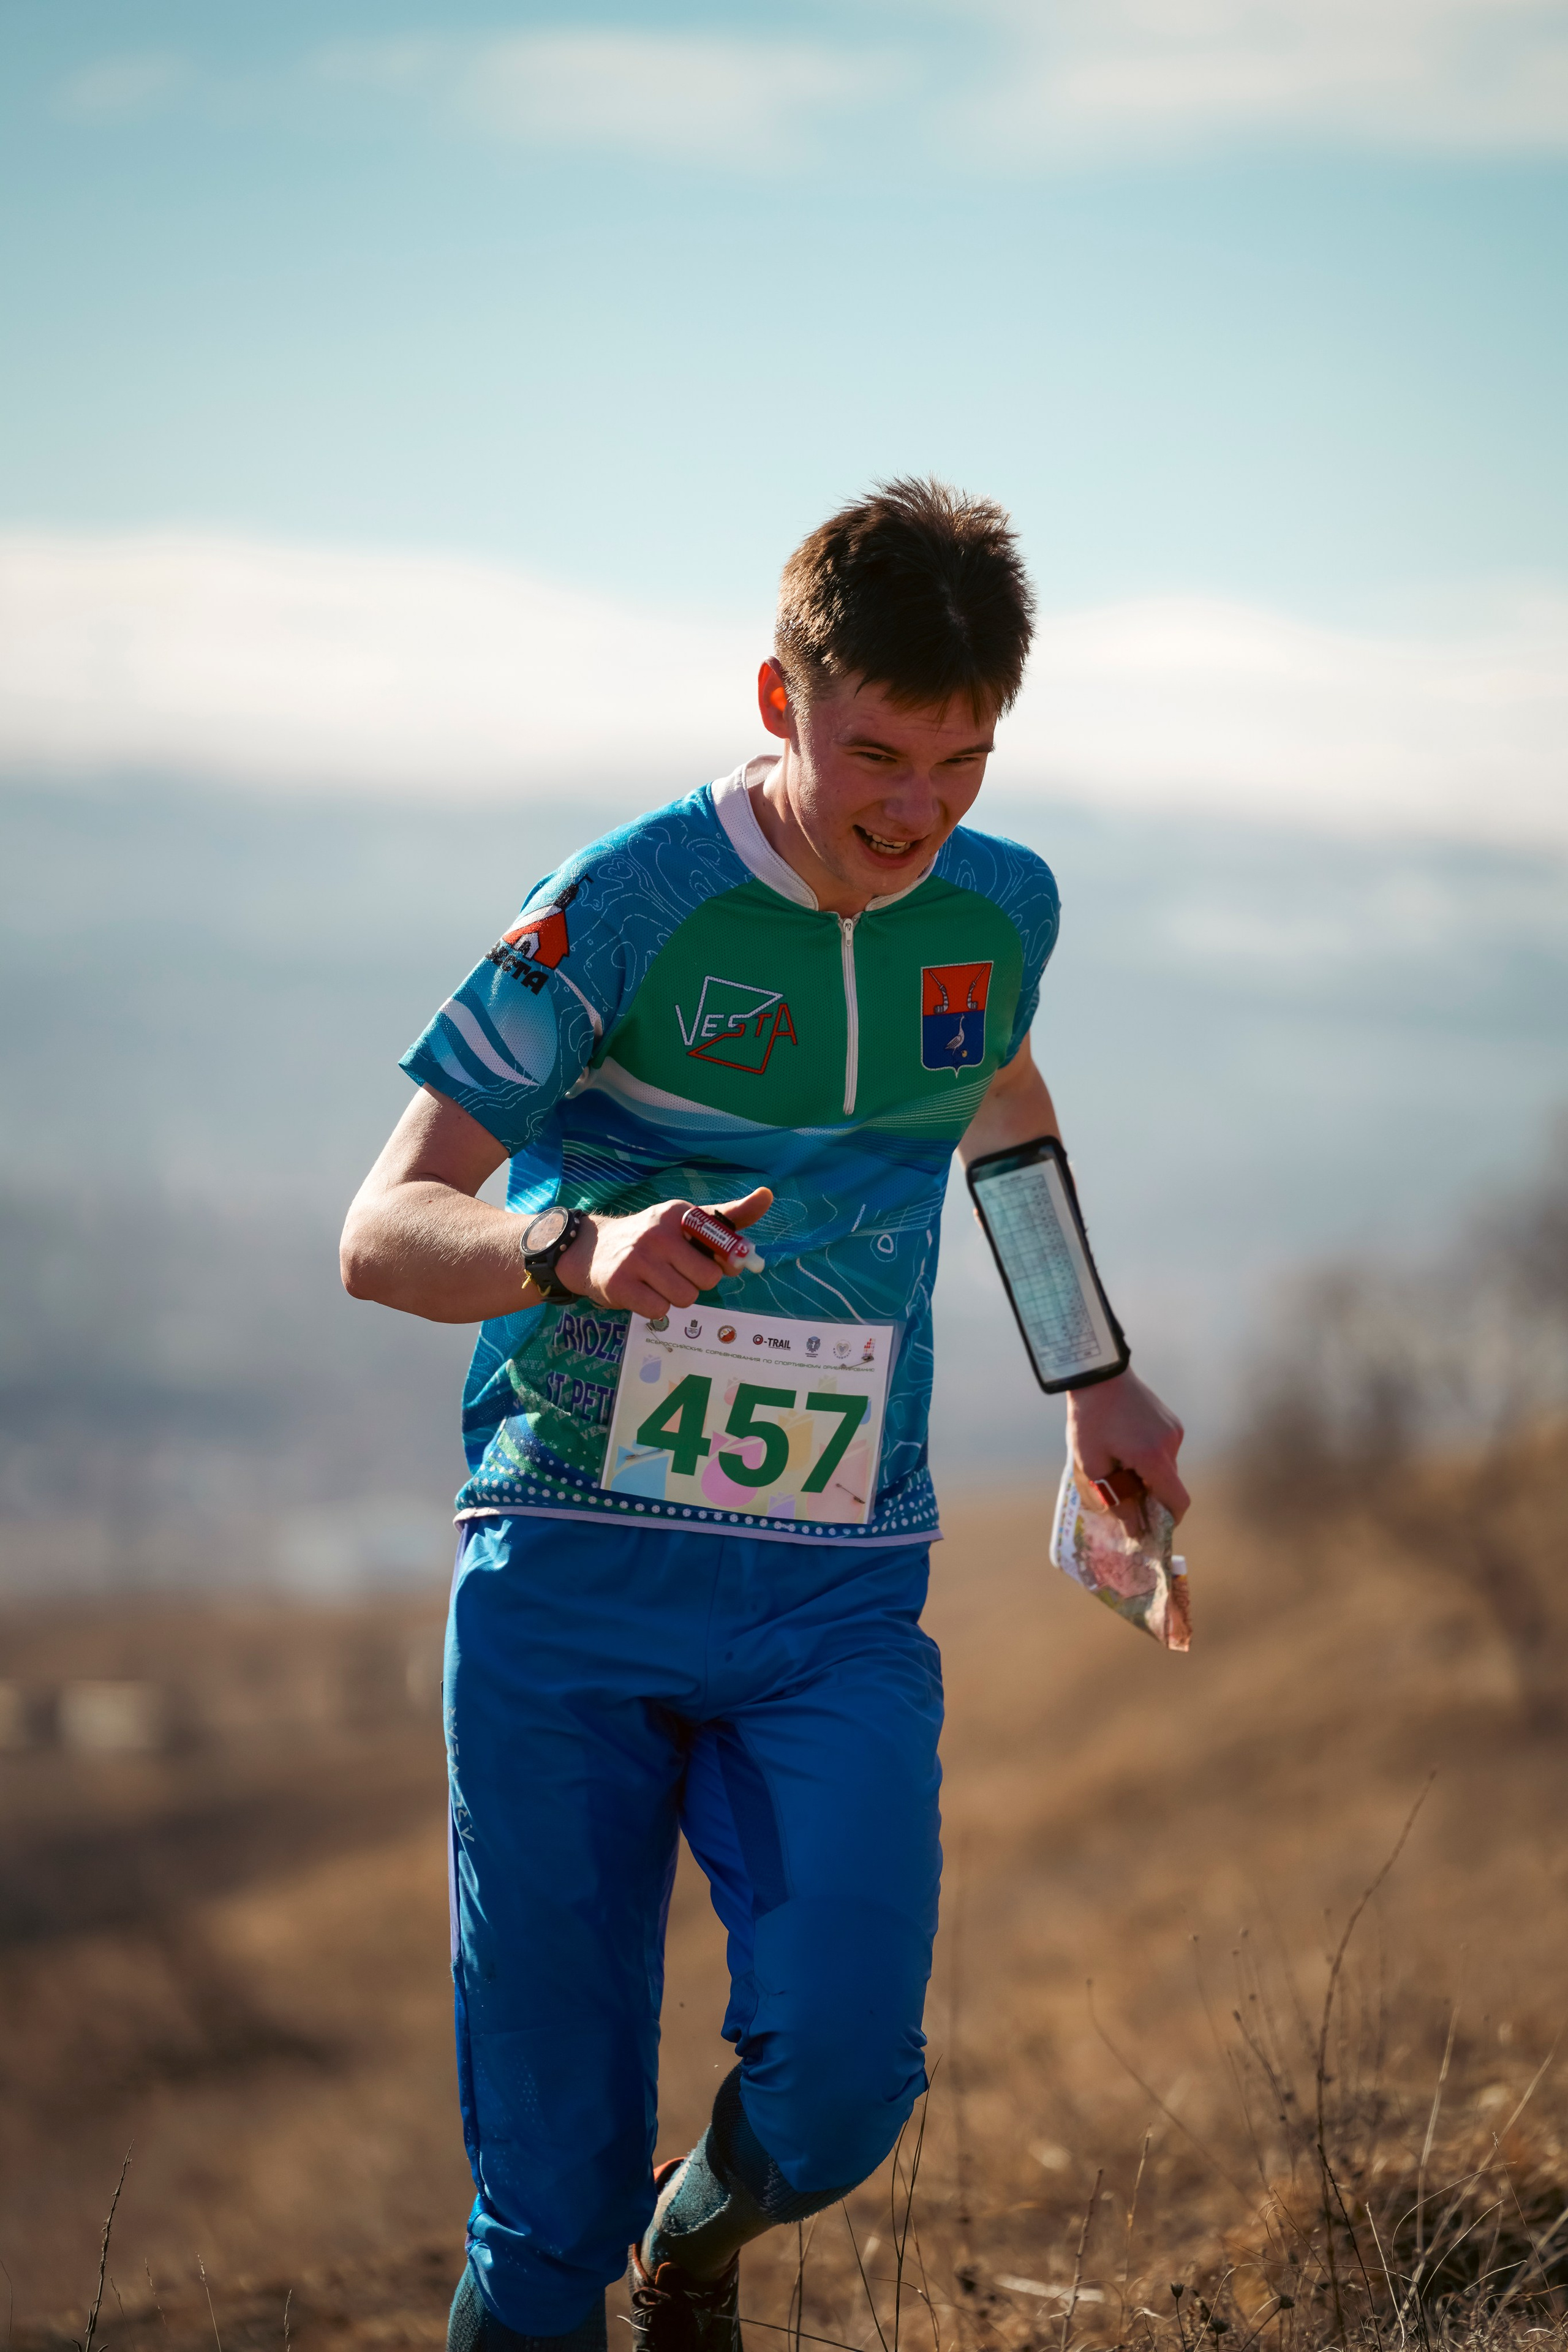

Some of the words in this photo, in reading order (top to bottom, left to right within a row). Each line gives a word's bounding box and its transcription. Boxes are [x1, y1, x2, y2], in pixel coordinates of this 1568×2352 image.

[706, 1349, 761, 1362] СОРЕВНОВАНИЯ
[774, 1360, 821, 1369] СПОРТИВНОМУ
[636, 1374, 869, 1493] 457
